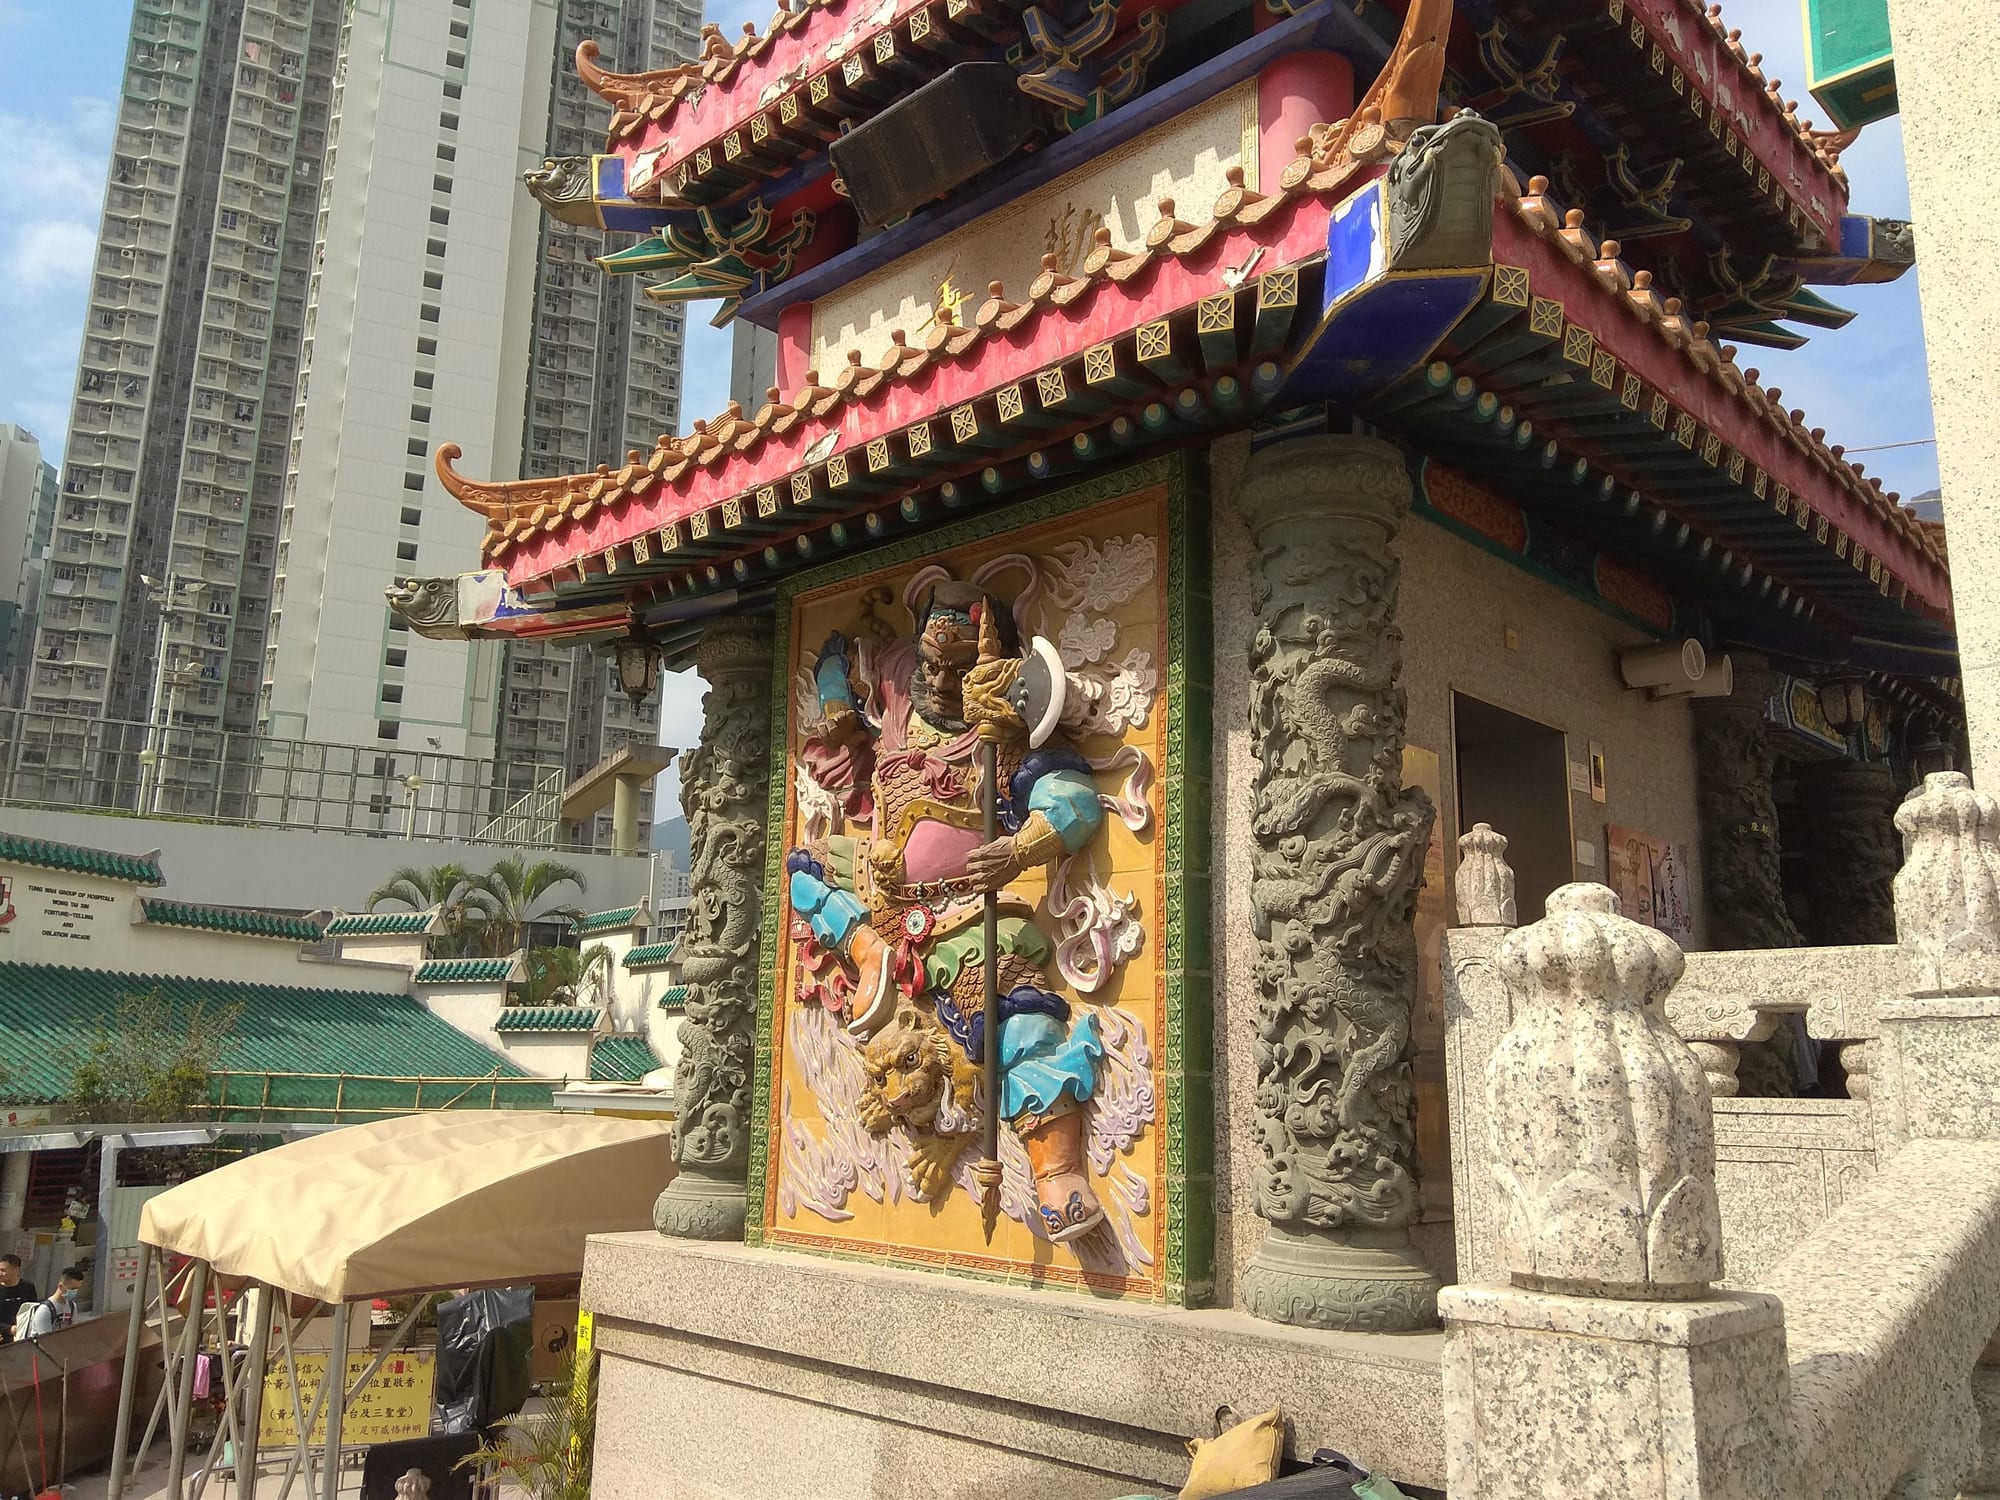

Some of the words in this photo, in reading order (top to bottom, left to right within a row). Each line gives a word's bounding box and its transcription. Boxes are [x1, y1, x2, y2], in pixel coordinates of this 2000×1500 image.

[58, 889, 77, 897] GROUP
[87, 893, 115, 902] HOSPITALS
[52, 899, 68, 907] WONG
[44, 908, 94, 920] FORTUNE-TELLING
